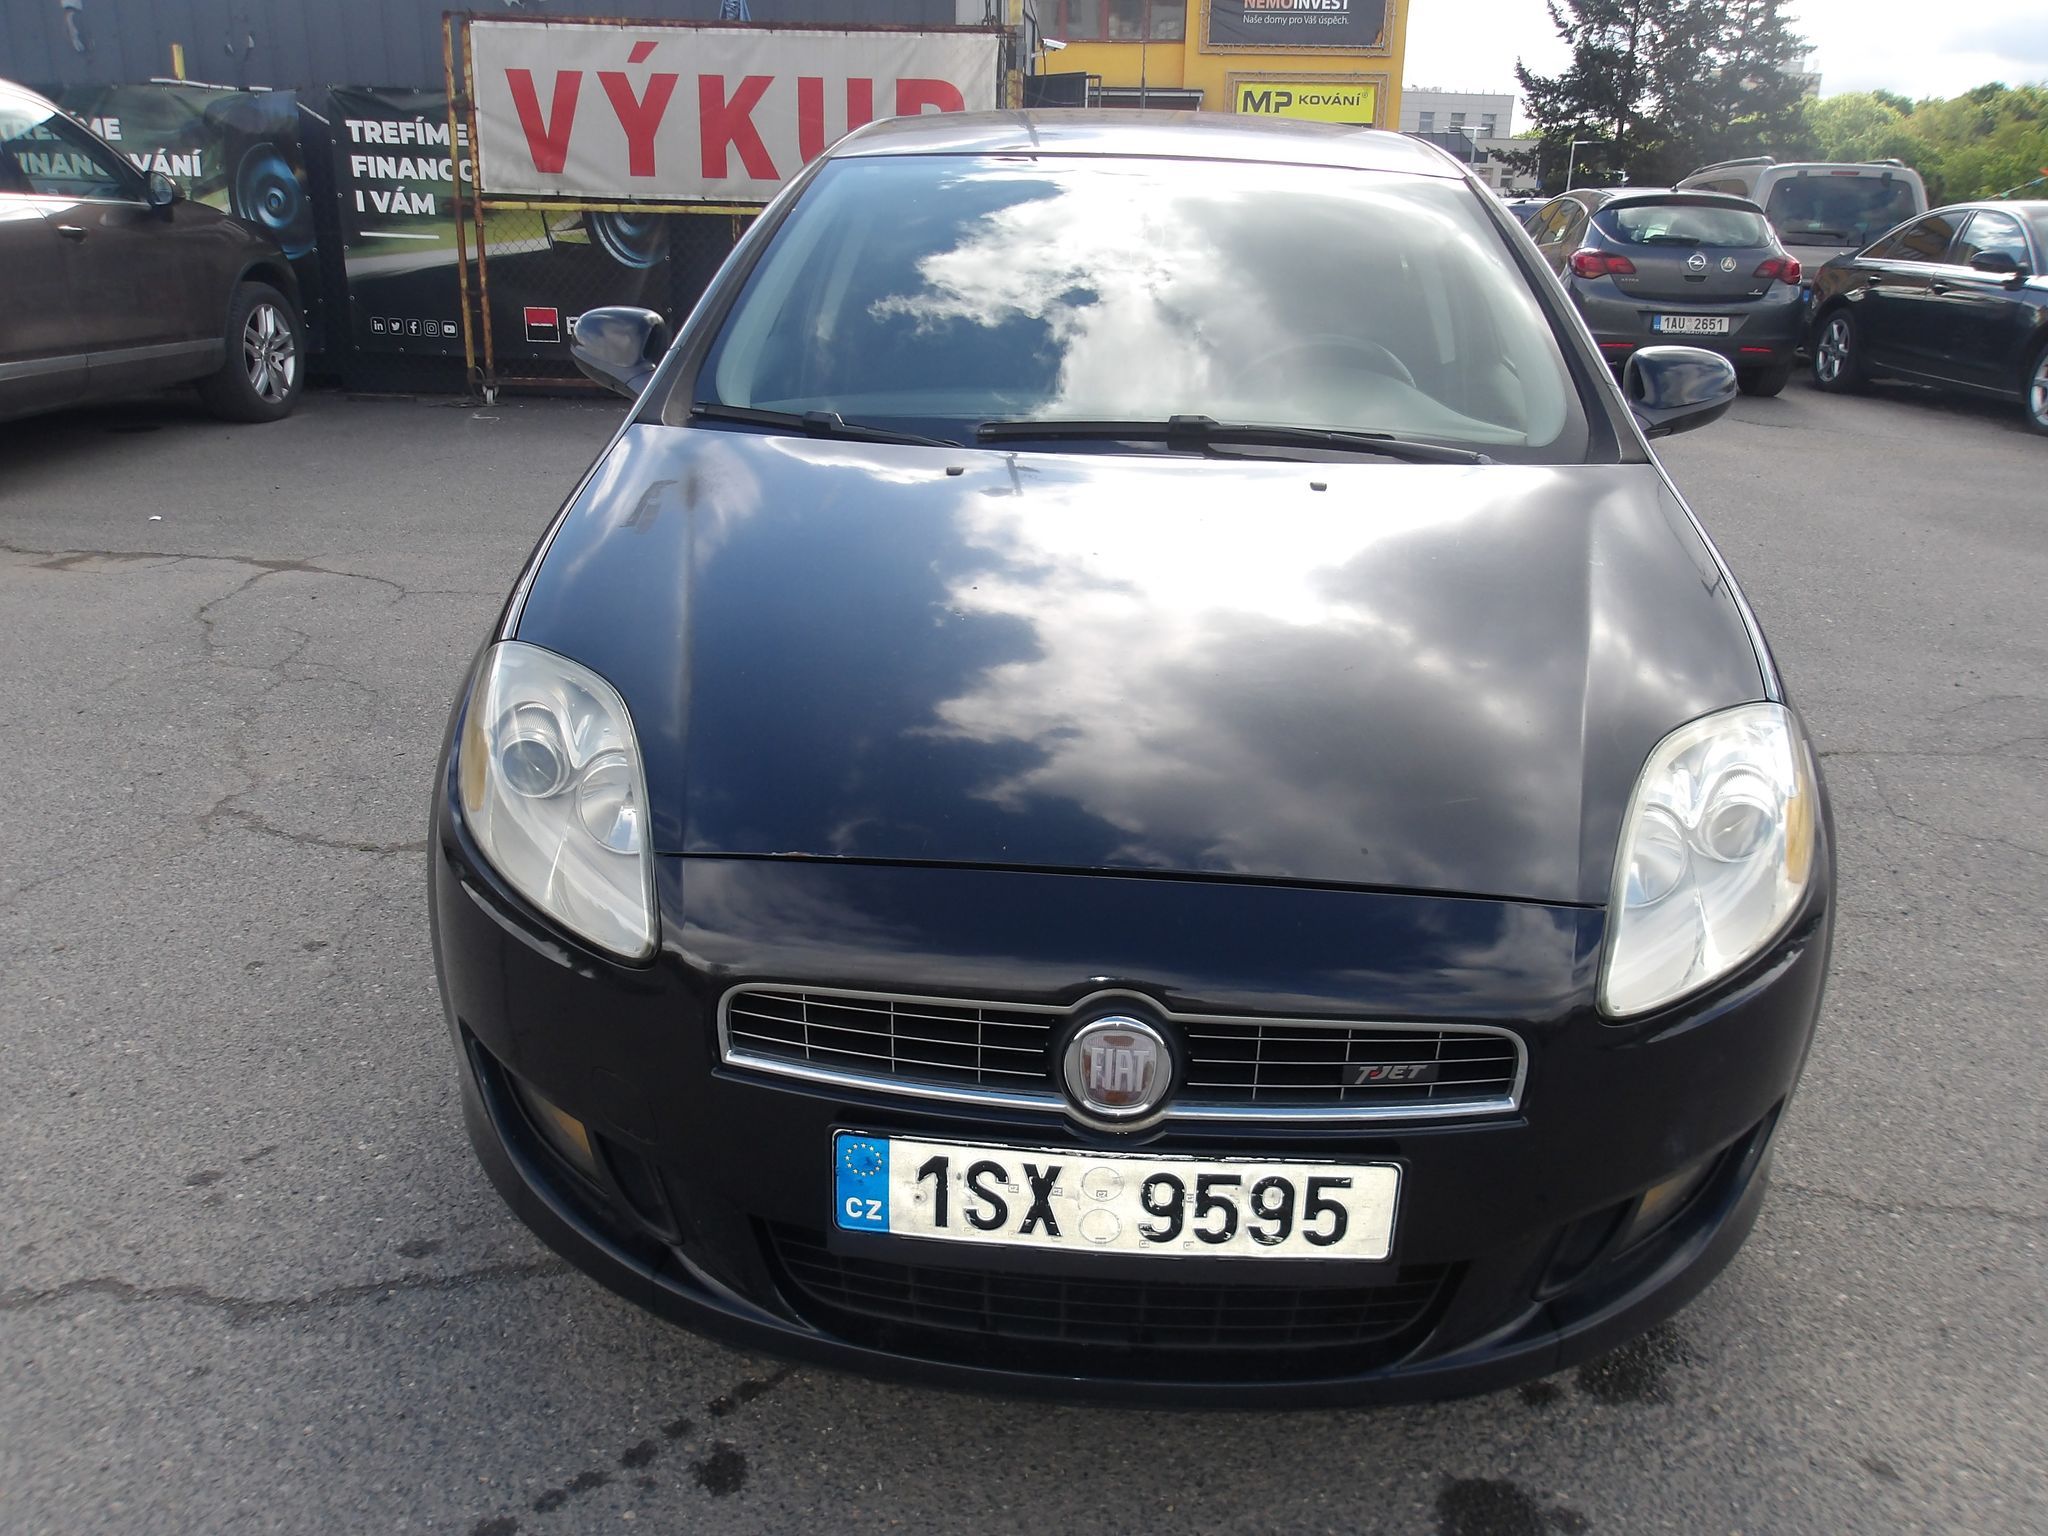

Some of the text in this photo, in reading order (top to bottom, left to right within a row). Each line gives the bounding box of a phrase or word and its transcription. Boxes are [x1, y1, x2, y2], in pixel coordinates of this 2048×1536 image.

[1243, 15, 1262, 24] Naše
[1264, 15, 1287, 25] domy
[1289, 17, 1303, 25] pro
[1304, 15, 1317, 24] Váš
[1242, 90, 1361, 113] MP KOVÁNÍ
[345, 116, 469, 146] TREFÍME
[355, 186, 436, 215] I VÁM
[1665, 317, 1686, 329] 1AU
[1694, 318, 1723, 330] 2651
[1089, 1046, 1150, 1093] FIAT
[845, 1198, 882, 1220] CZ
[914, 1156, 1354, 1246] 1SX 9595
